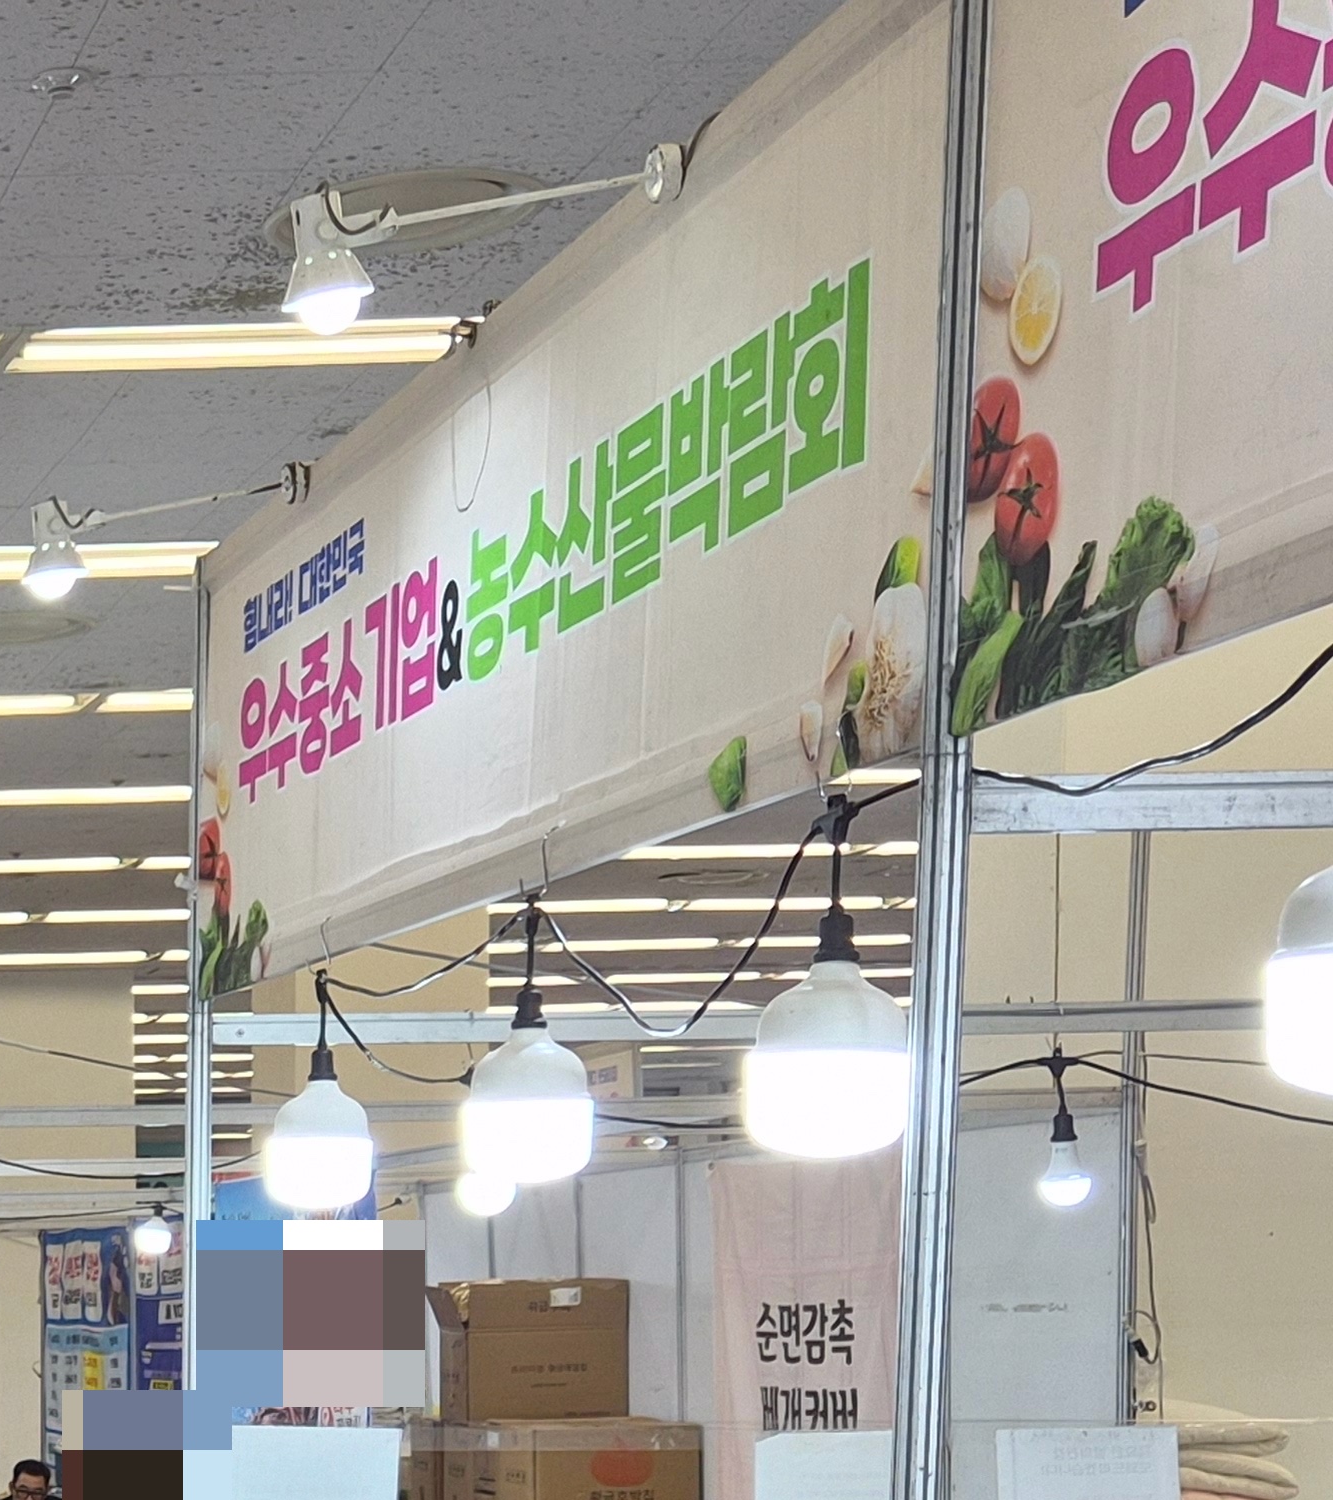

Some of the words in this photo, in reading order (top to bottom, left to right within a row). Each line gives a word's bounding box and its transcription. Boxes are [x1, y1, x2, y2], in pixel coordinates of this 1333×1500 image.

[1096, 0, 1333, 312] 우수
[243, 578, 295, 654] 힘내라!
[297, 517, 367, 620] 대한민국
[755, 1298, 855, 1366] 순면감촉
[760, 1386, 858, 1431] 베개커버
